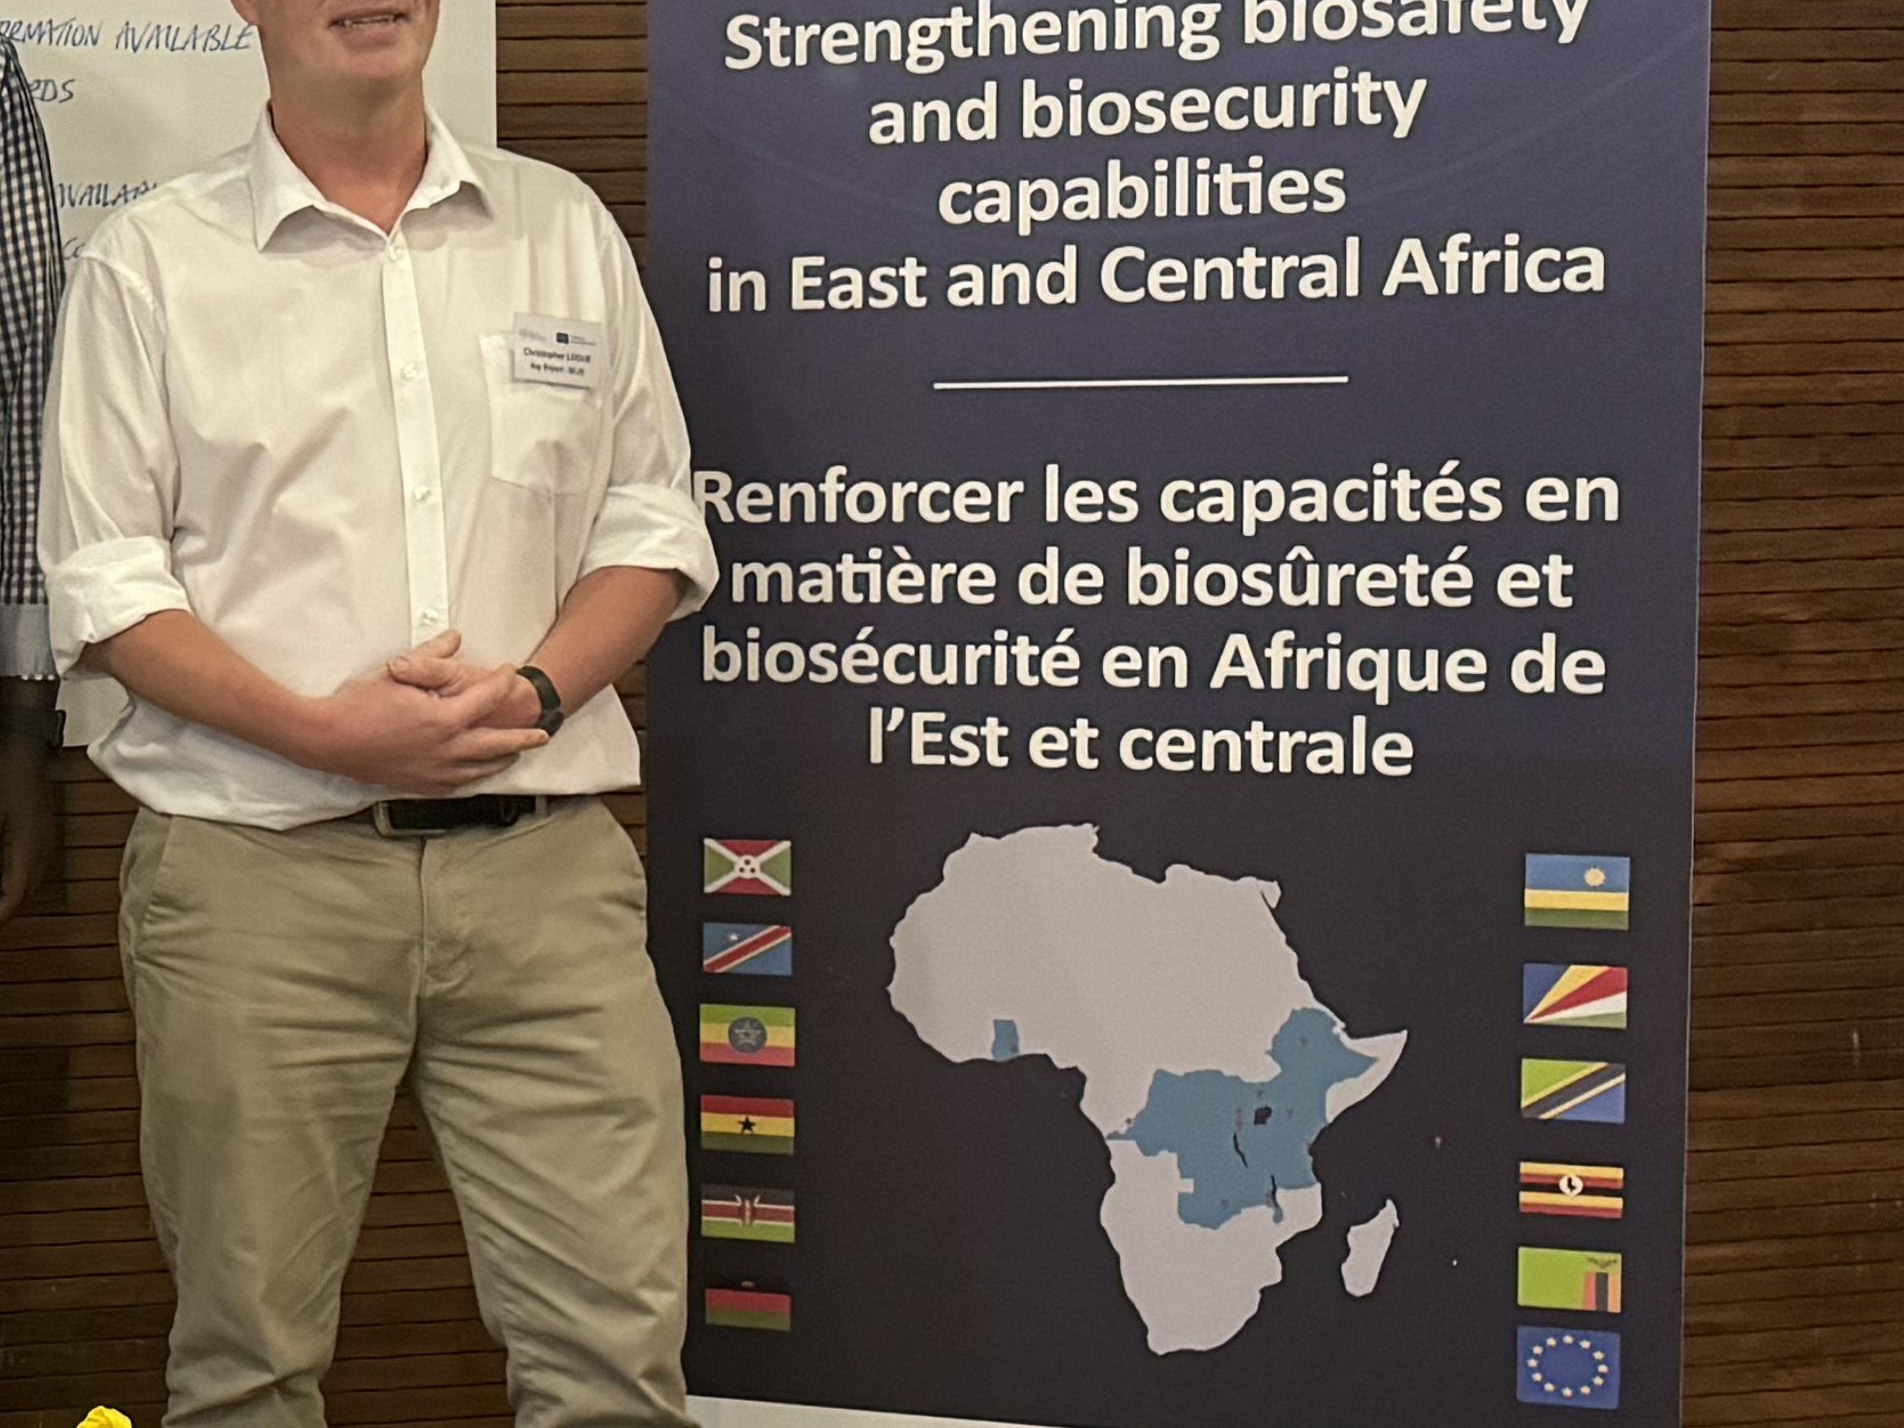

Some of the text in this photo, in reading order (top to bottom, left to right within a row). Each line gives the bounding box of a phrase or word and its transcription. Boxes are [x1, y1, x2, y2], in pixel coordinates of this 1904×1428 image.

[114, 20, 254, 54] AVAILABLE
[868, 69, 1428, 145] and biosecurity
[937, 154, 1347, 236] capabilities
[706, 231, 1606, 313] in East and Central Africa
[692, 460, 1621, 536] Renforcer les capacités en
[729, 545, 1574, 609] matière de biosûreté et
[700, 625, 1606, 705] biosécurité en Afrique de
[1038, 716, 1100, 770] et
[1117, 715, 1415, 776] centrale
